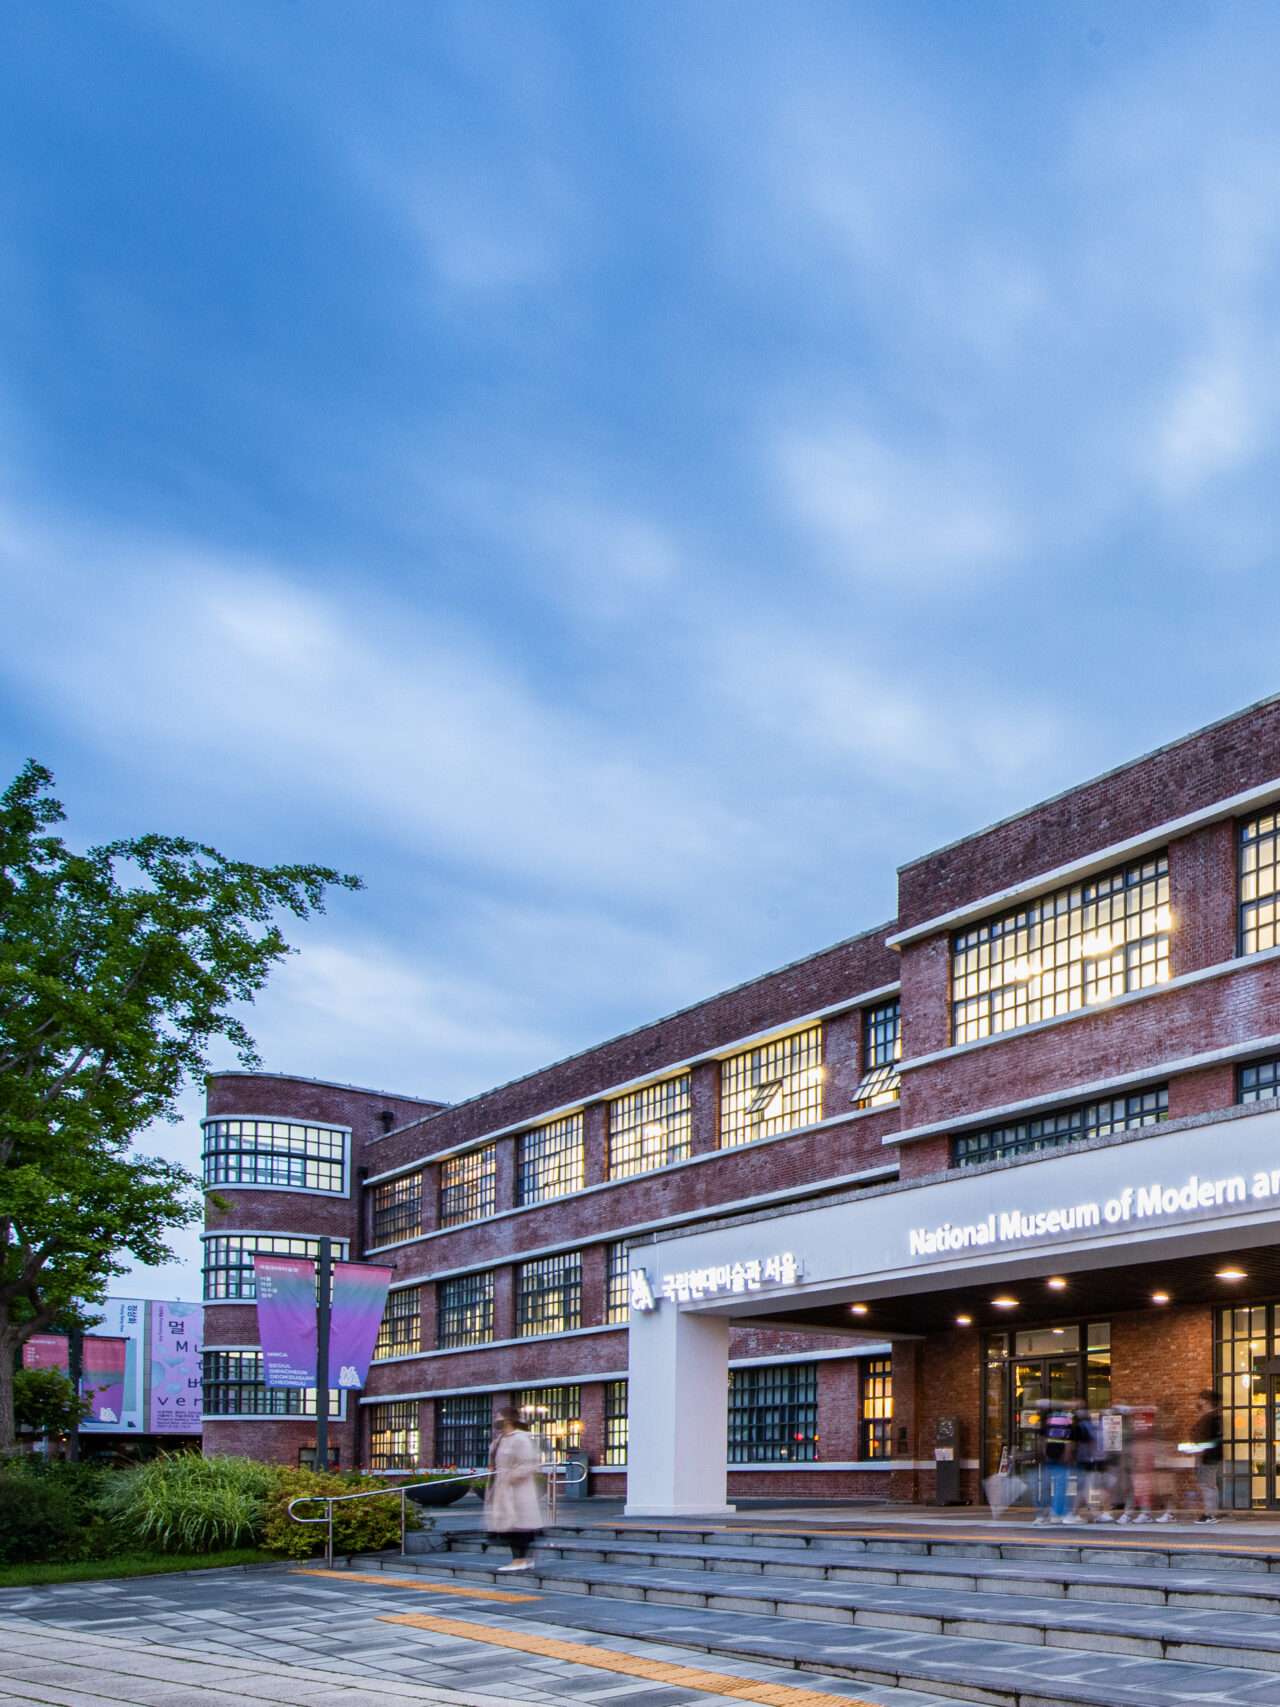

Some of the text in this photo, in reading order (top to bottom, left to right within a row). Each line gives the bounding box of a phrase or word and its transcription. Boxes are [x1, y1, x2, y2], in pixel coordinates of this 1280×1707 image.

[910, 1215, 995, 1255] National
[1000, 1202, 1100, 1241] Museum
[1104, 1188, 1135, 1223] of
[1137, 1175, 1246, 1218] Modern
[661, 1252, 797, 1302] 국립현대미술관 서울
